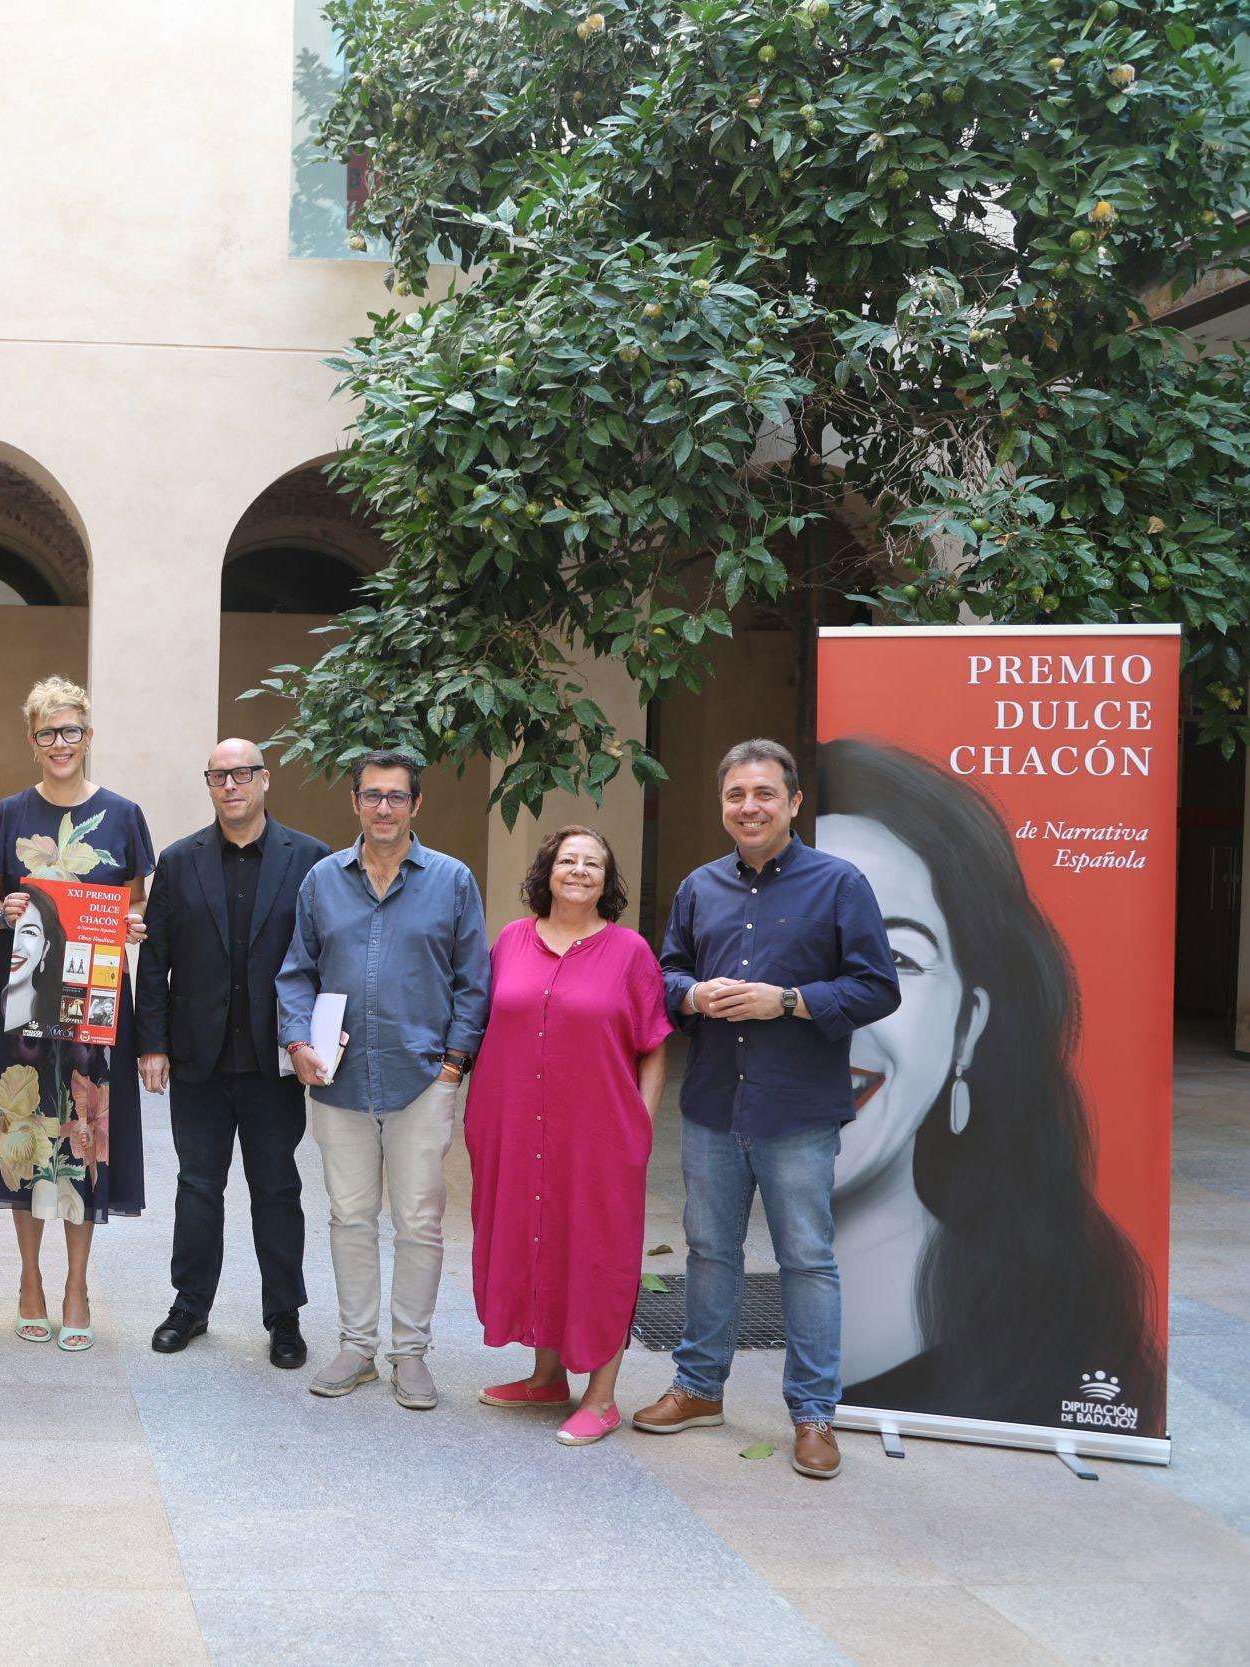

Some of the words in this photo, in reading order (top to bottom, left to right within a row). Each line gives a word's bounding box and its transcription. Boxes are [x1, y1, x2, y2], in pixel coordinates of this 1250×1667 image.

[967, 654, 1152, 685] PREMIO
[994, 700, 1152, 730] DULCE
[949, 739, 1153, 776] CHACÓN
[1015, 820, 1038, 839] de
[1042, 820, 1150, 842] Narrativa
[1052, 849, 1146, 873] Española
[67, 888, 83, 897] XXI
[86, 890, 121, 901] PREMIO
[89, 903, 119, 913] DULCE
[1061, 1400, 1138, 1418] DIPUTACIÓN
[1061, 1413, 1074, 1422] DE
[1076, 1412, 1137, 1429] BADAJOZ
